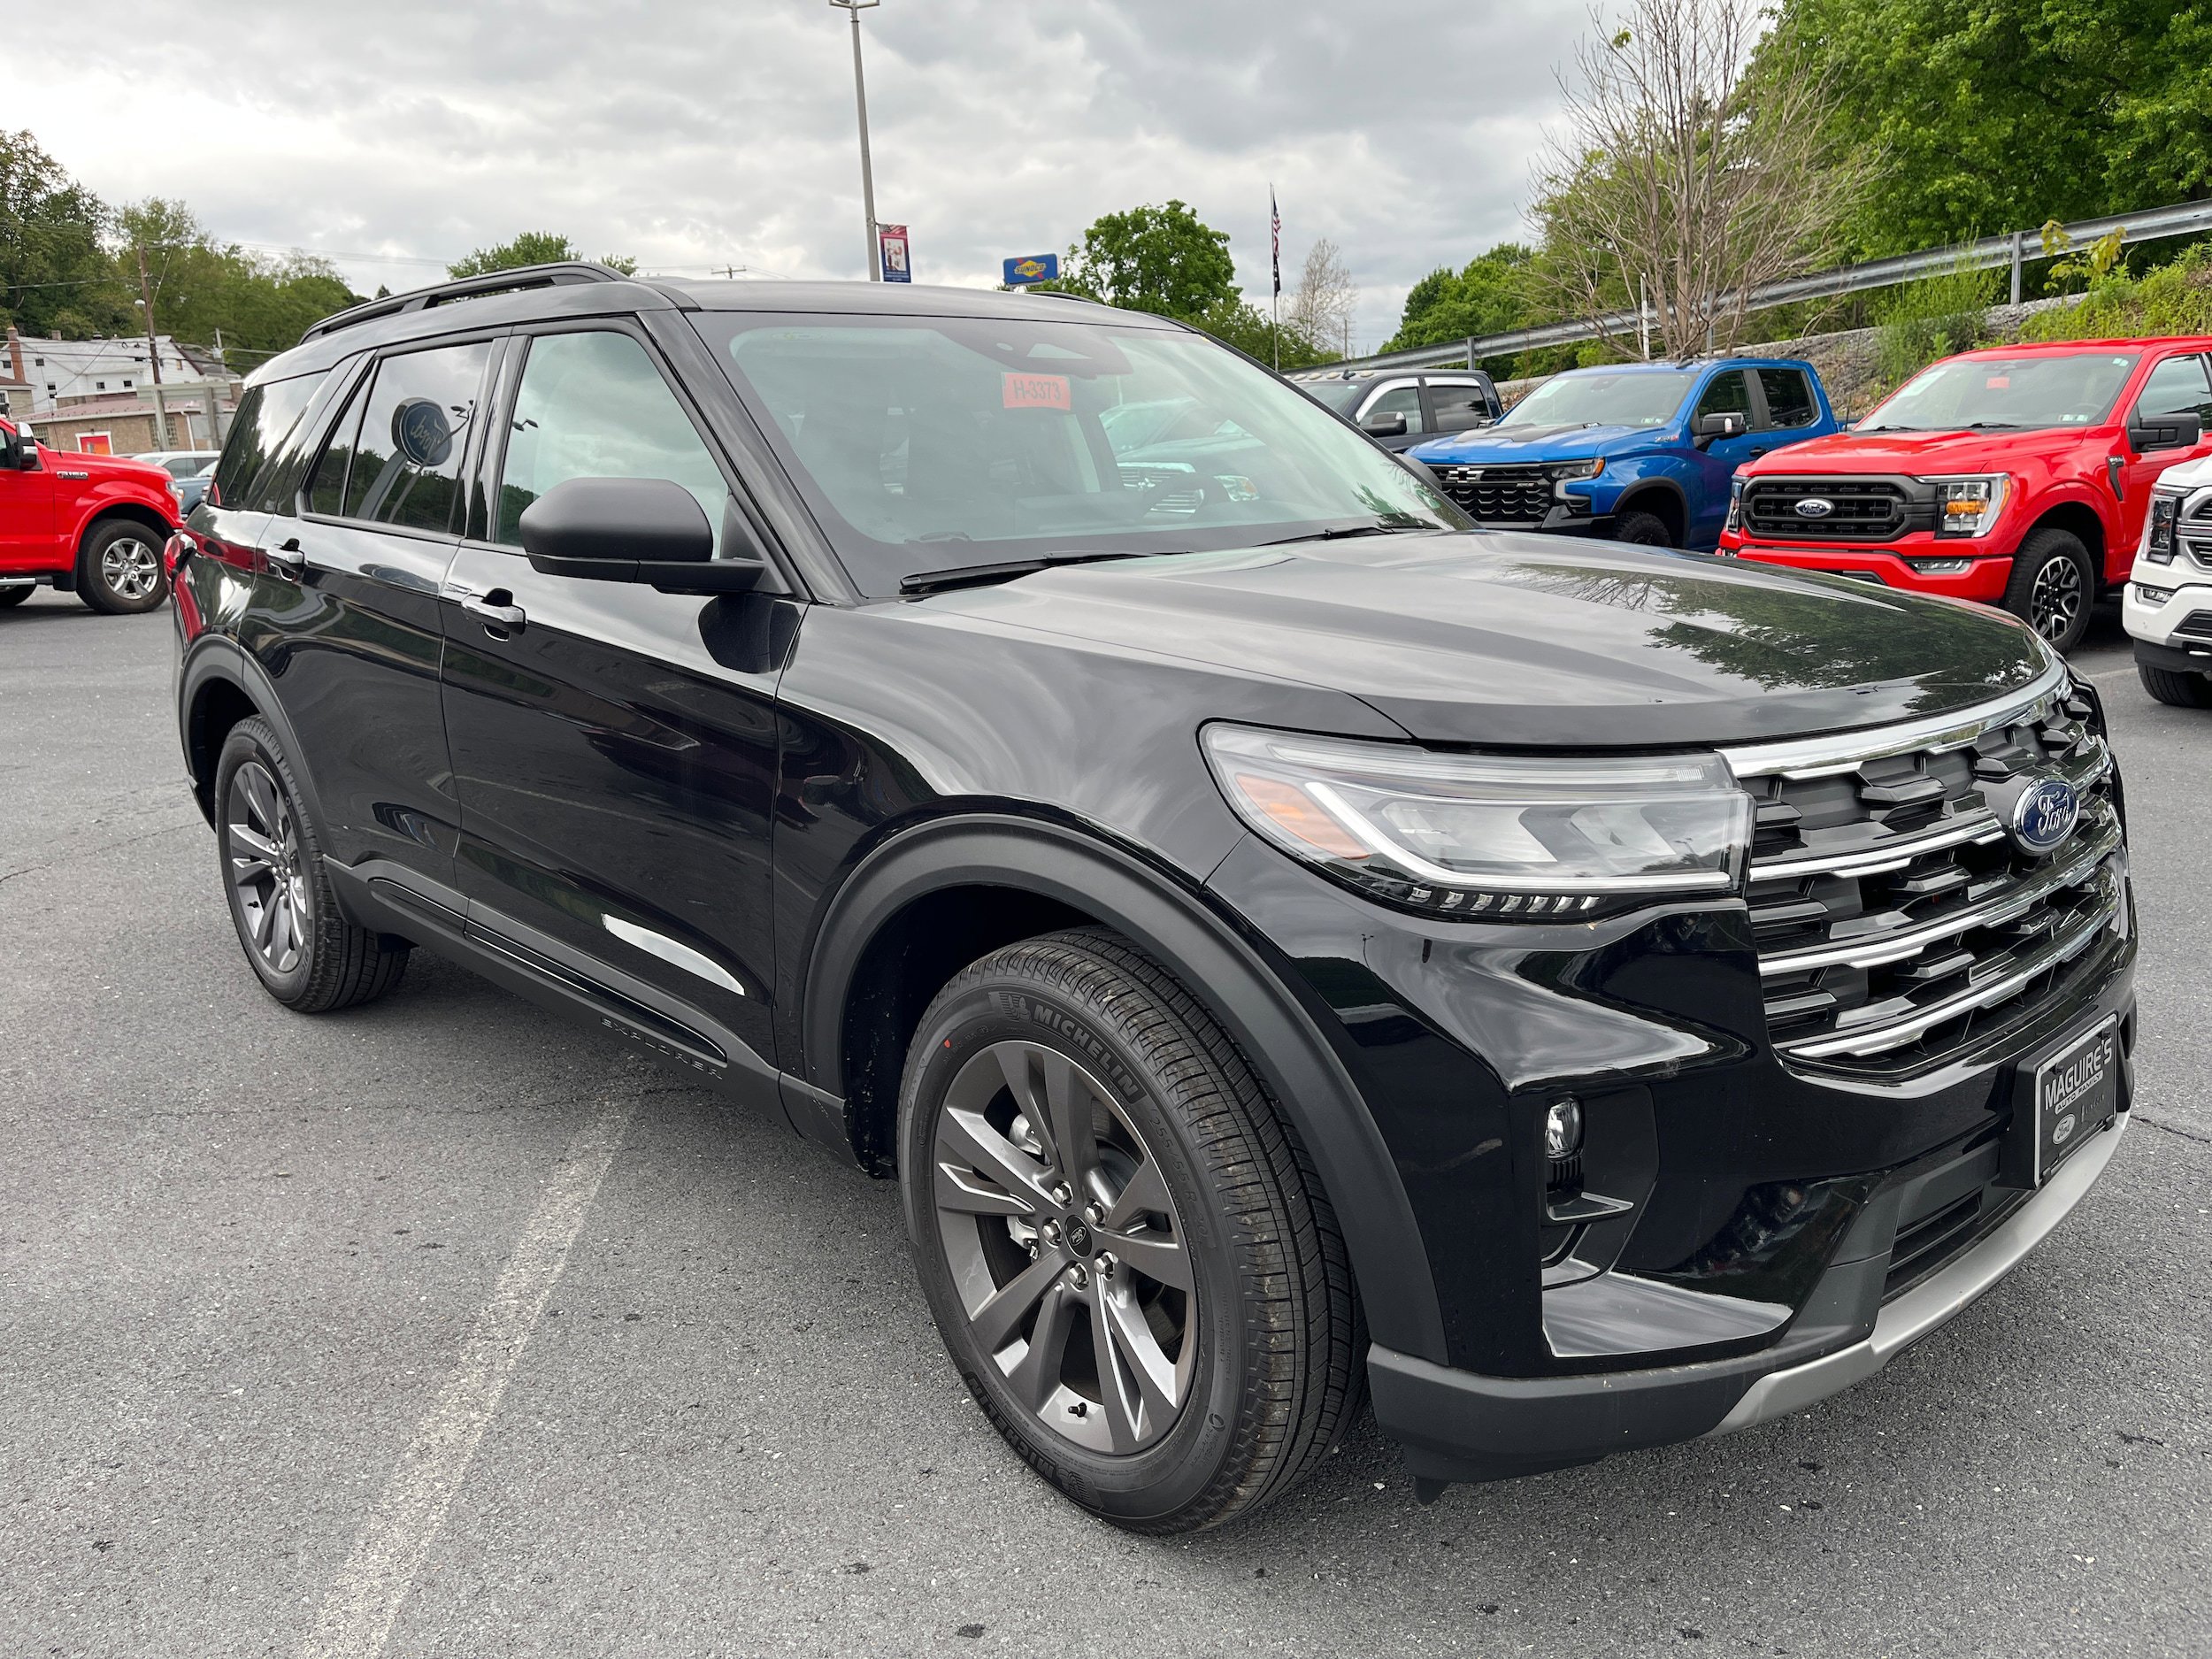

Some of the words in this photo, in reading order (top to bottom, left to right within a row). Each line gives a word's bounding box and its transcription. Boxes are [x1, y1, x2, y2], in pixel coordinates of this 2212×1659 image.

[1014, 263, 1047, 274] SUNOCO
[1013, 380, 1061, 401] H-3373
[2038, 790, 2071, 836] Ford
[601, 1017, 723, 1080] EXPLORER
[1033, 1004, 1139, 1096] MICHELIN
[2045, 1037, 2112, 1110] MAGUIRE'S
[2057, 1093, 2077, 1110] AUTO
[2078, 1072, 2101, 1094] FAMILY
[1149, 1116, 1190, 1183] 255/55
[968, 1378, 1055, 1477] MICHELIN
